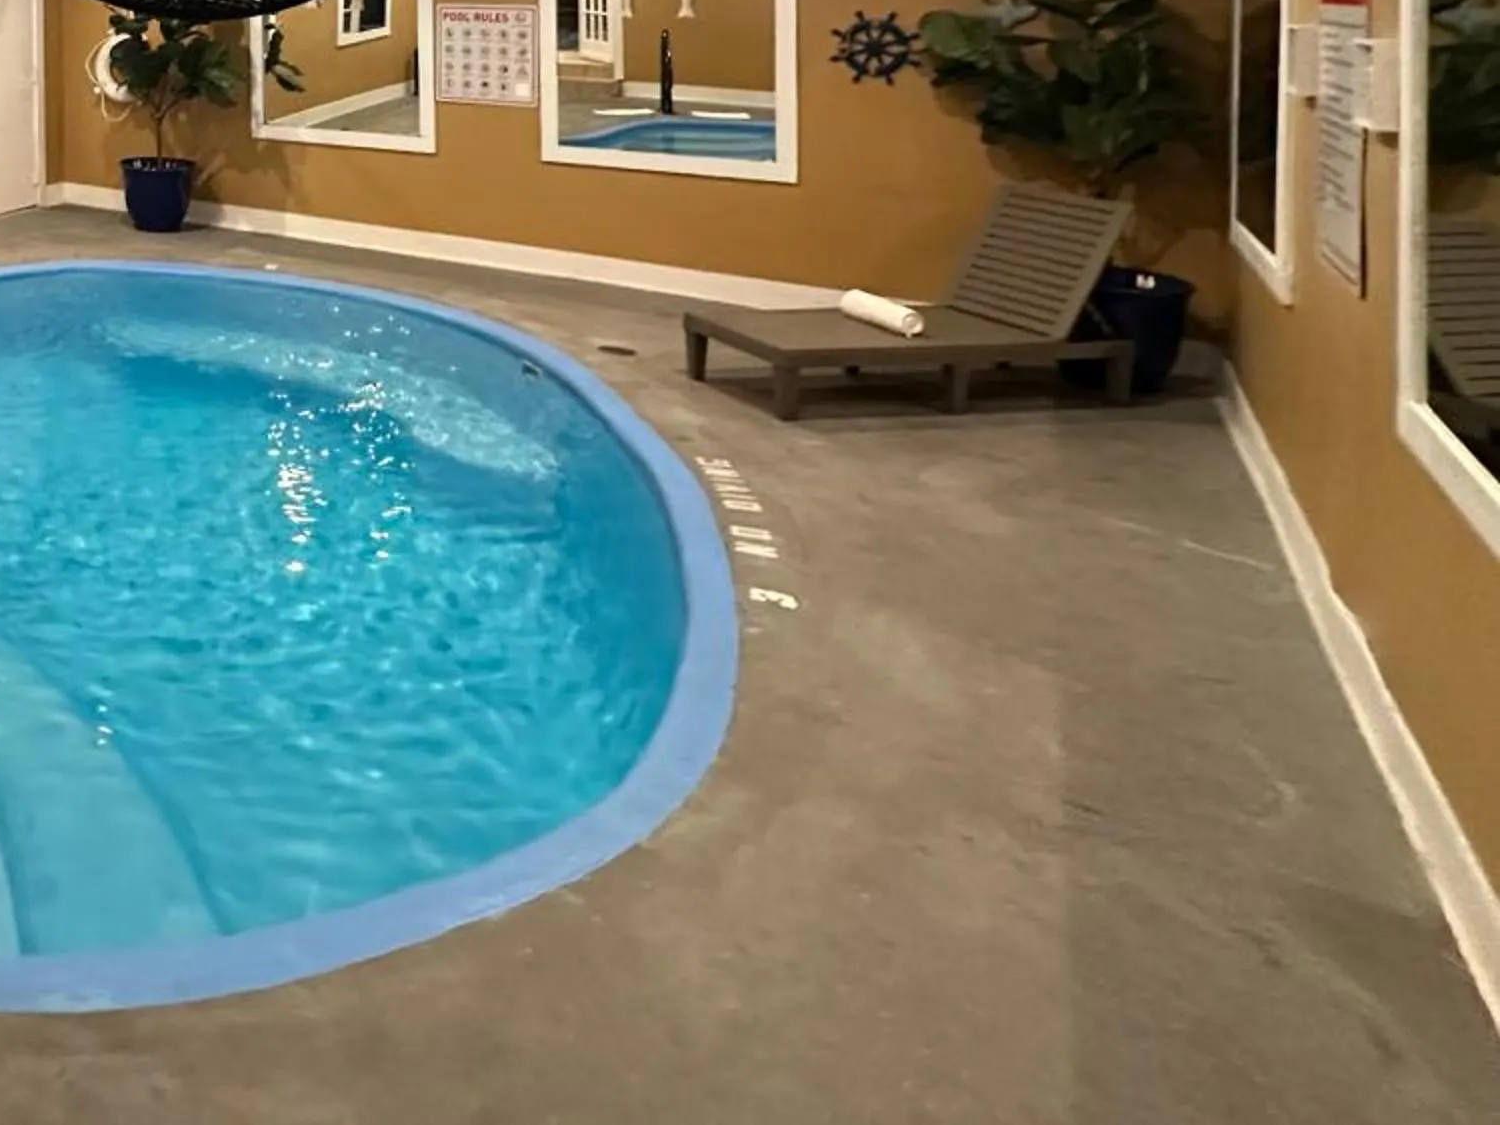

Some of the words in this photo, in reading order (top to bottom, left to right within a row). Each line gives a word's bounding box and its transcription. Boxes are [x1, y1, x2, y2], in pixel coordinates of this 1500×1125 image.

[443, 12, 470, 22] POOL
[473, 12, 509, 24] RULES
[694, 456, 763, 513] DIVING
[729, 525, 779, 558] NO
[748, 587, 799, 610] 3
